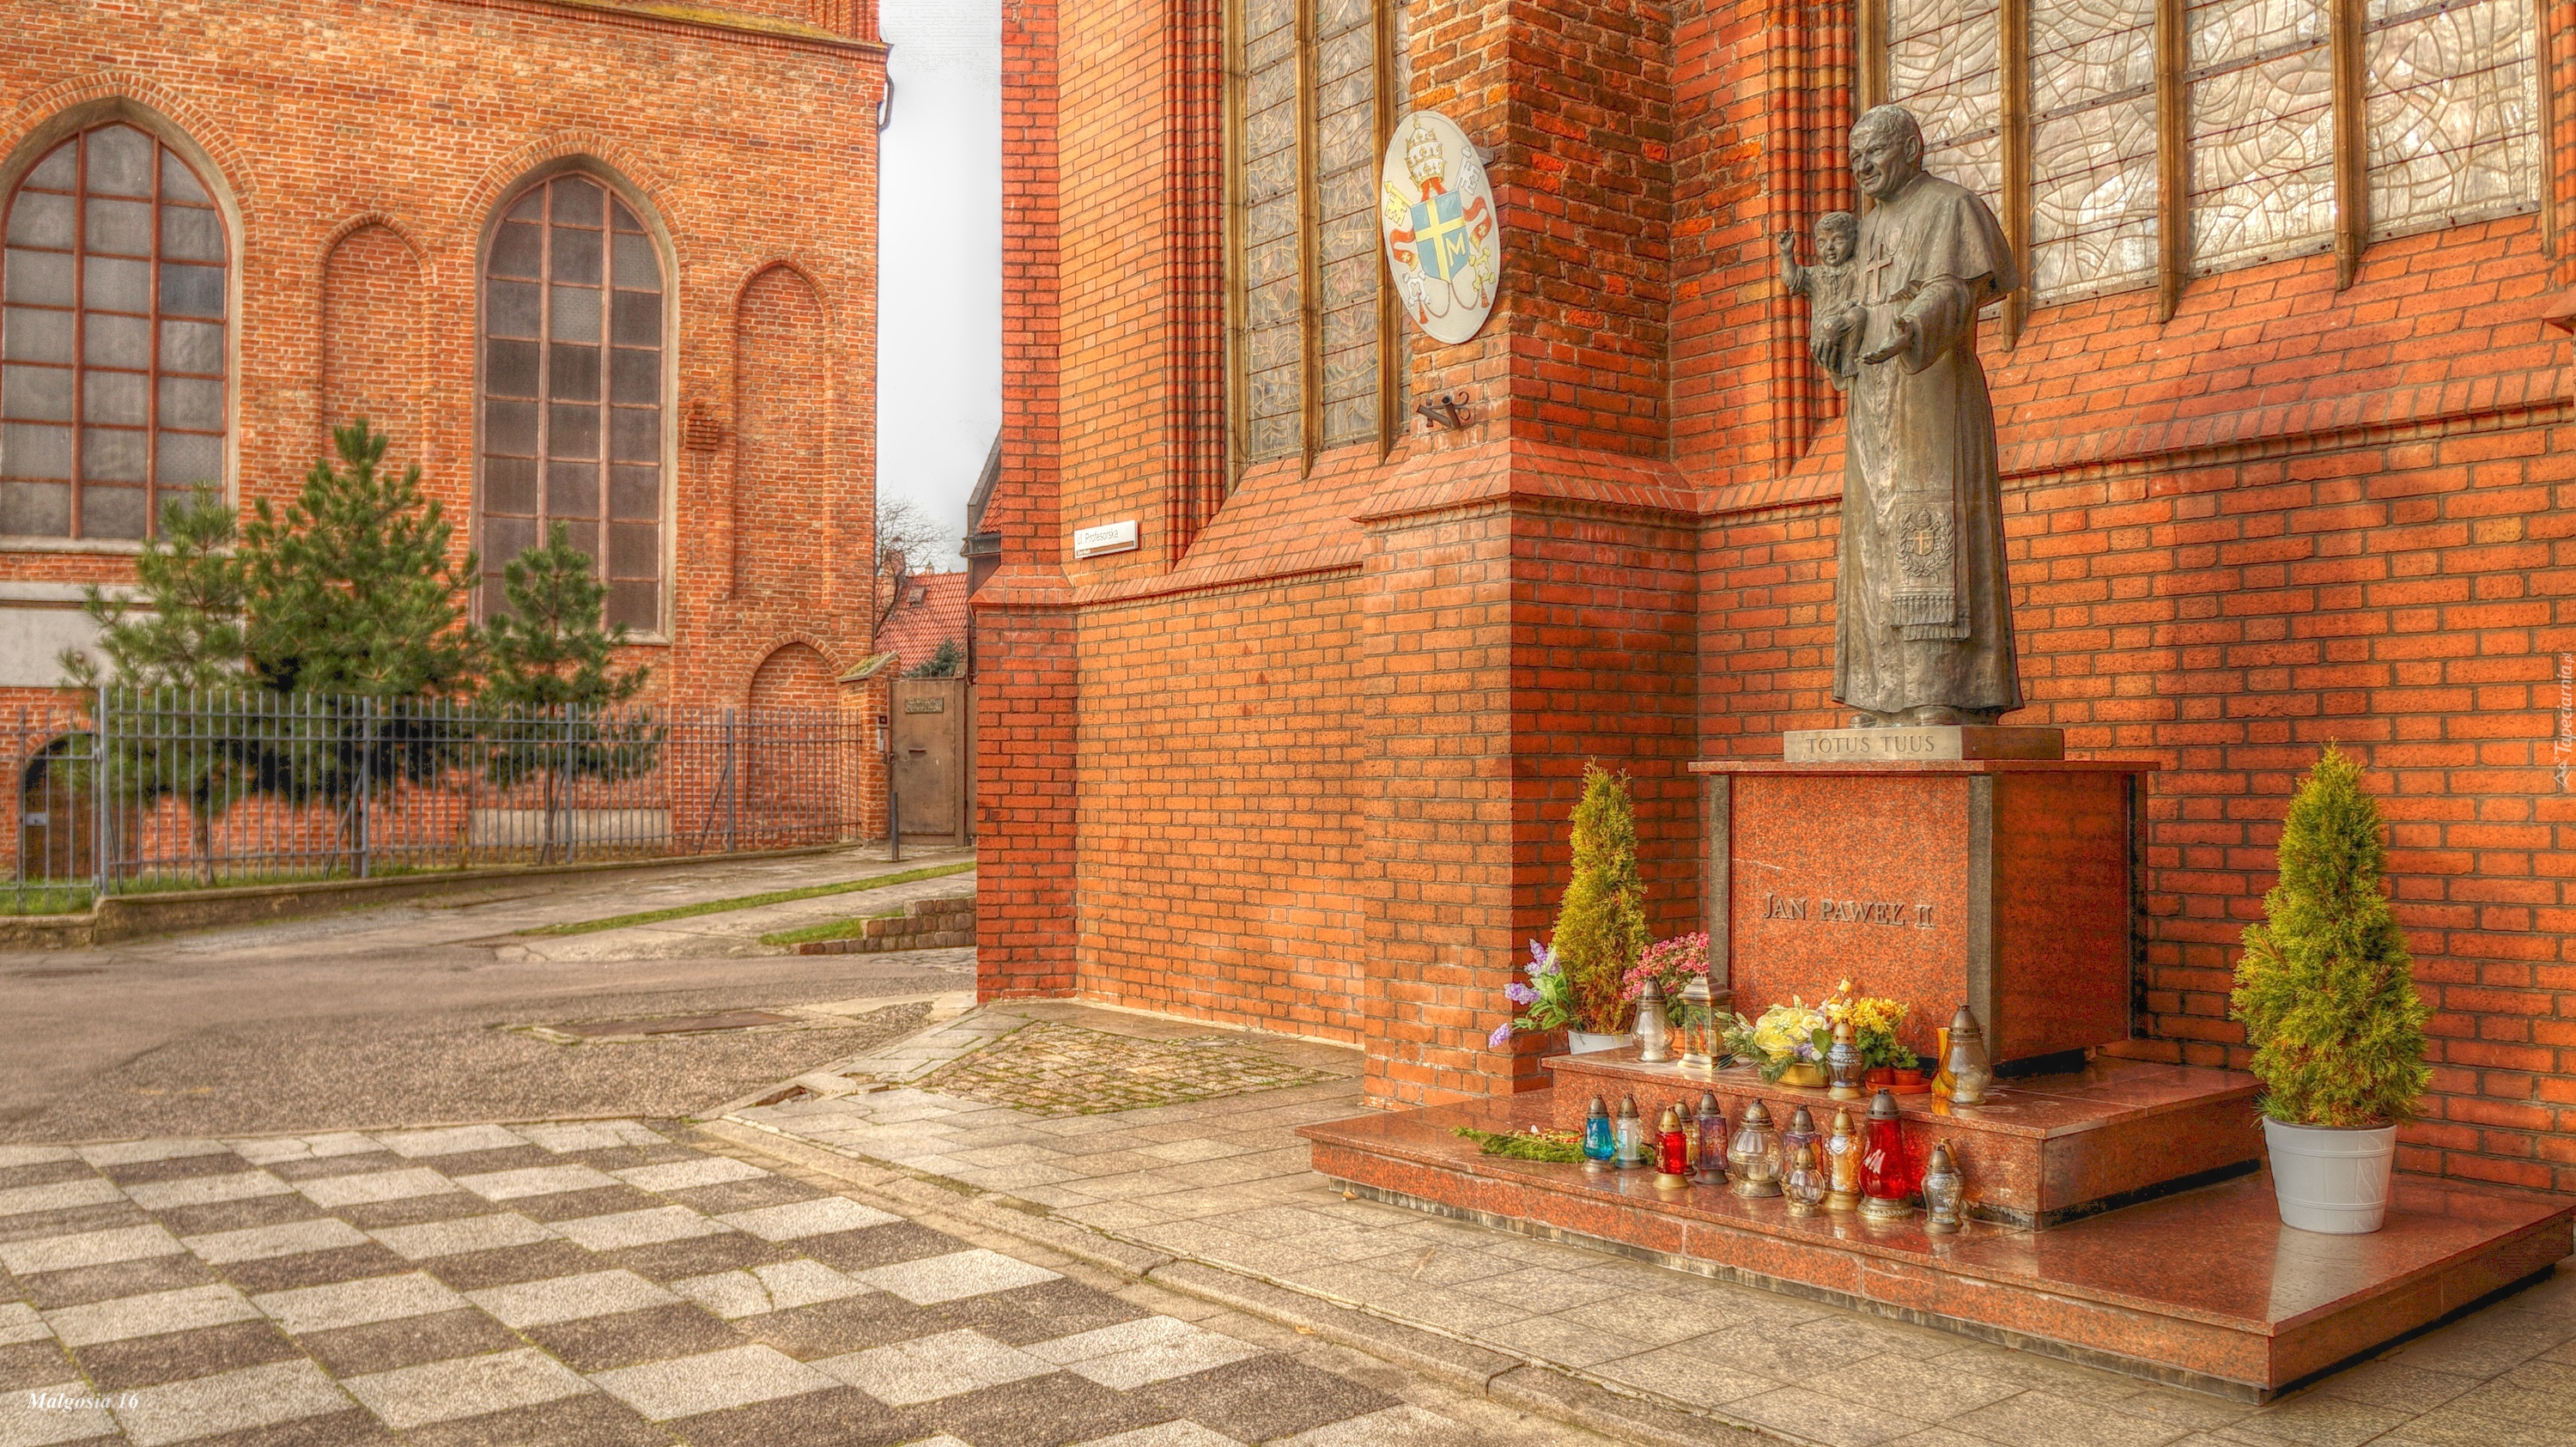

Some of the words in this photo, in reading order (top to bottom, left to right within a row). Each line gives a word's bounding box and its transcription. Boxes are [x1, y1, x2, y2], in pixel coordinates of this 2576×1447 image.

[1084, 528, 1118, 543] Profesorska
[1806, 737, 1870, 753] TOTUS
[1880, 733, 1935, 752] TUUS
[1763, 892, 1807, 921] JAN
[1820, 899, 1905, 926] PAWEŁ
[1915, 904, 1935, 928] II
